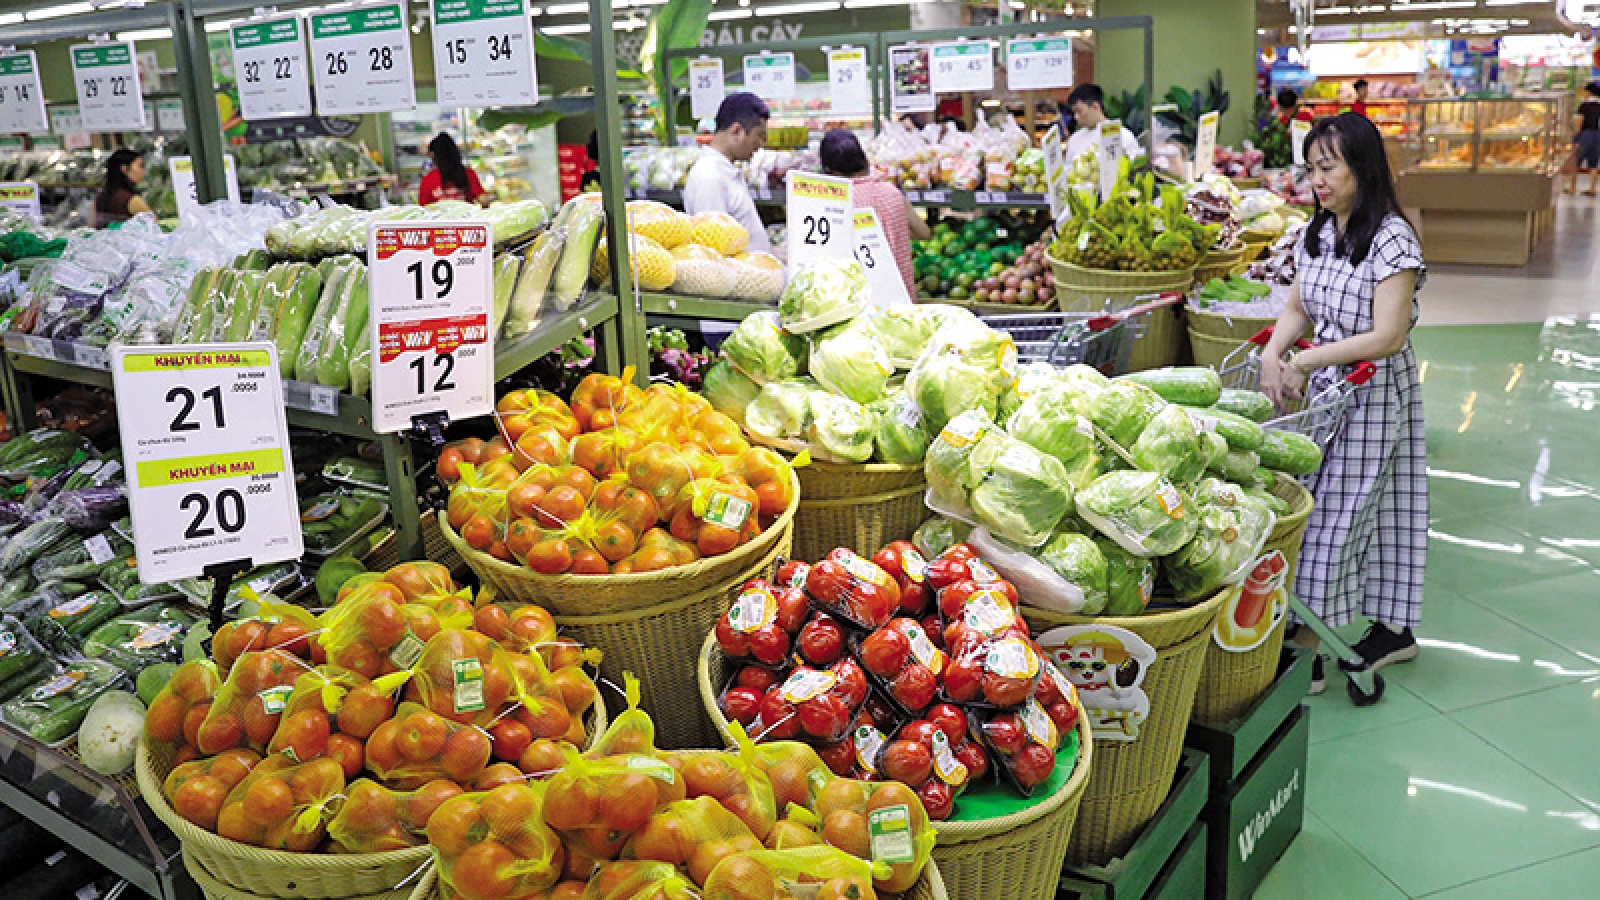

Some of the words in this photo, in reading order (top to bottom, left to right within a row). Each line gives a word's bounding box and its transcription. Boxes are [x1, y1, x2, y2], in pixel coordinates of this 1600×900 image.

[698, 21, 744, 47] RÁI
[751, 19, 804, 43] CÂY
[325, 51, 348, 75] 26
[369, 46, 393, 71] 28
[445, 39, 467, 64] 15
[488, 34, 512, 61] 34
[243, 62, 260, 82] 32
[273, 57, 292, 79] 22
[110, 76, 127, 96] 22
[803, 216, 831, 244] 29
[407, 259, 454, 300] 19
[154, 352, 212, 367] KHUYẾN
[410, 353, 455, 395] 12
[165, 385, 226, 432] 21
[169, 463, 227, 480] KHUYẾN
[230, 461, 255, 474] MẠI
[179, 488, 246, 540] 20
[1238, 768, 1299, 863] WinMart
